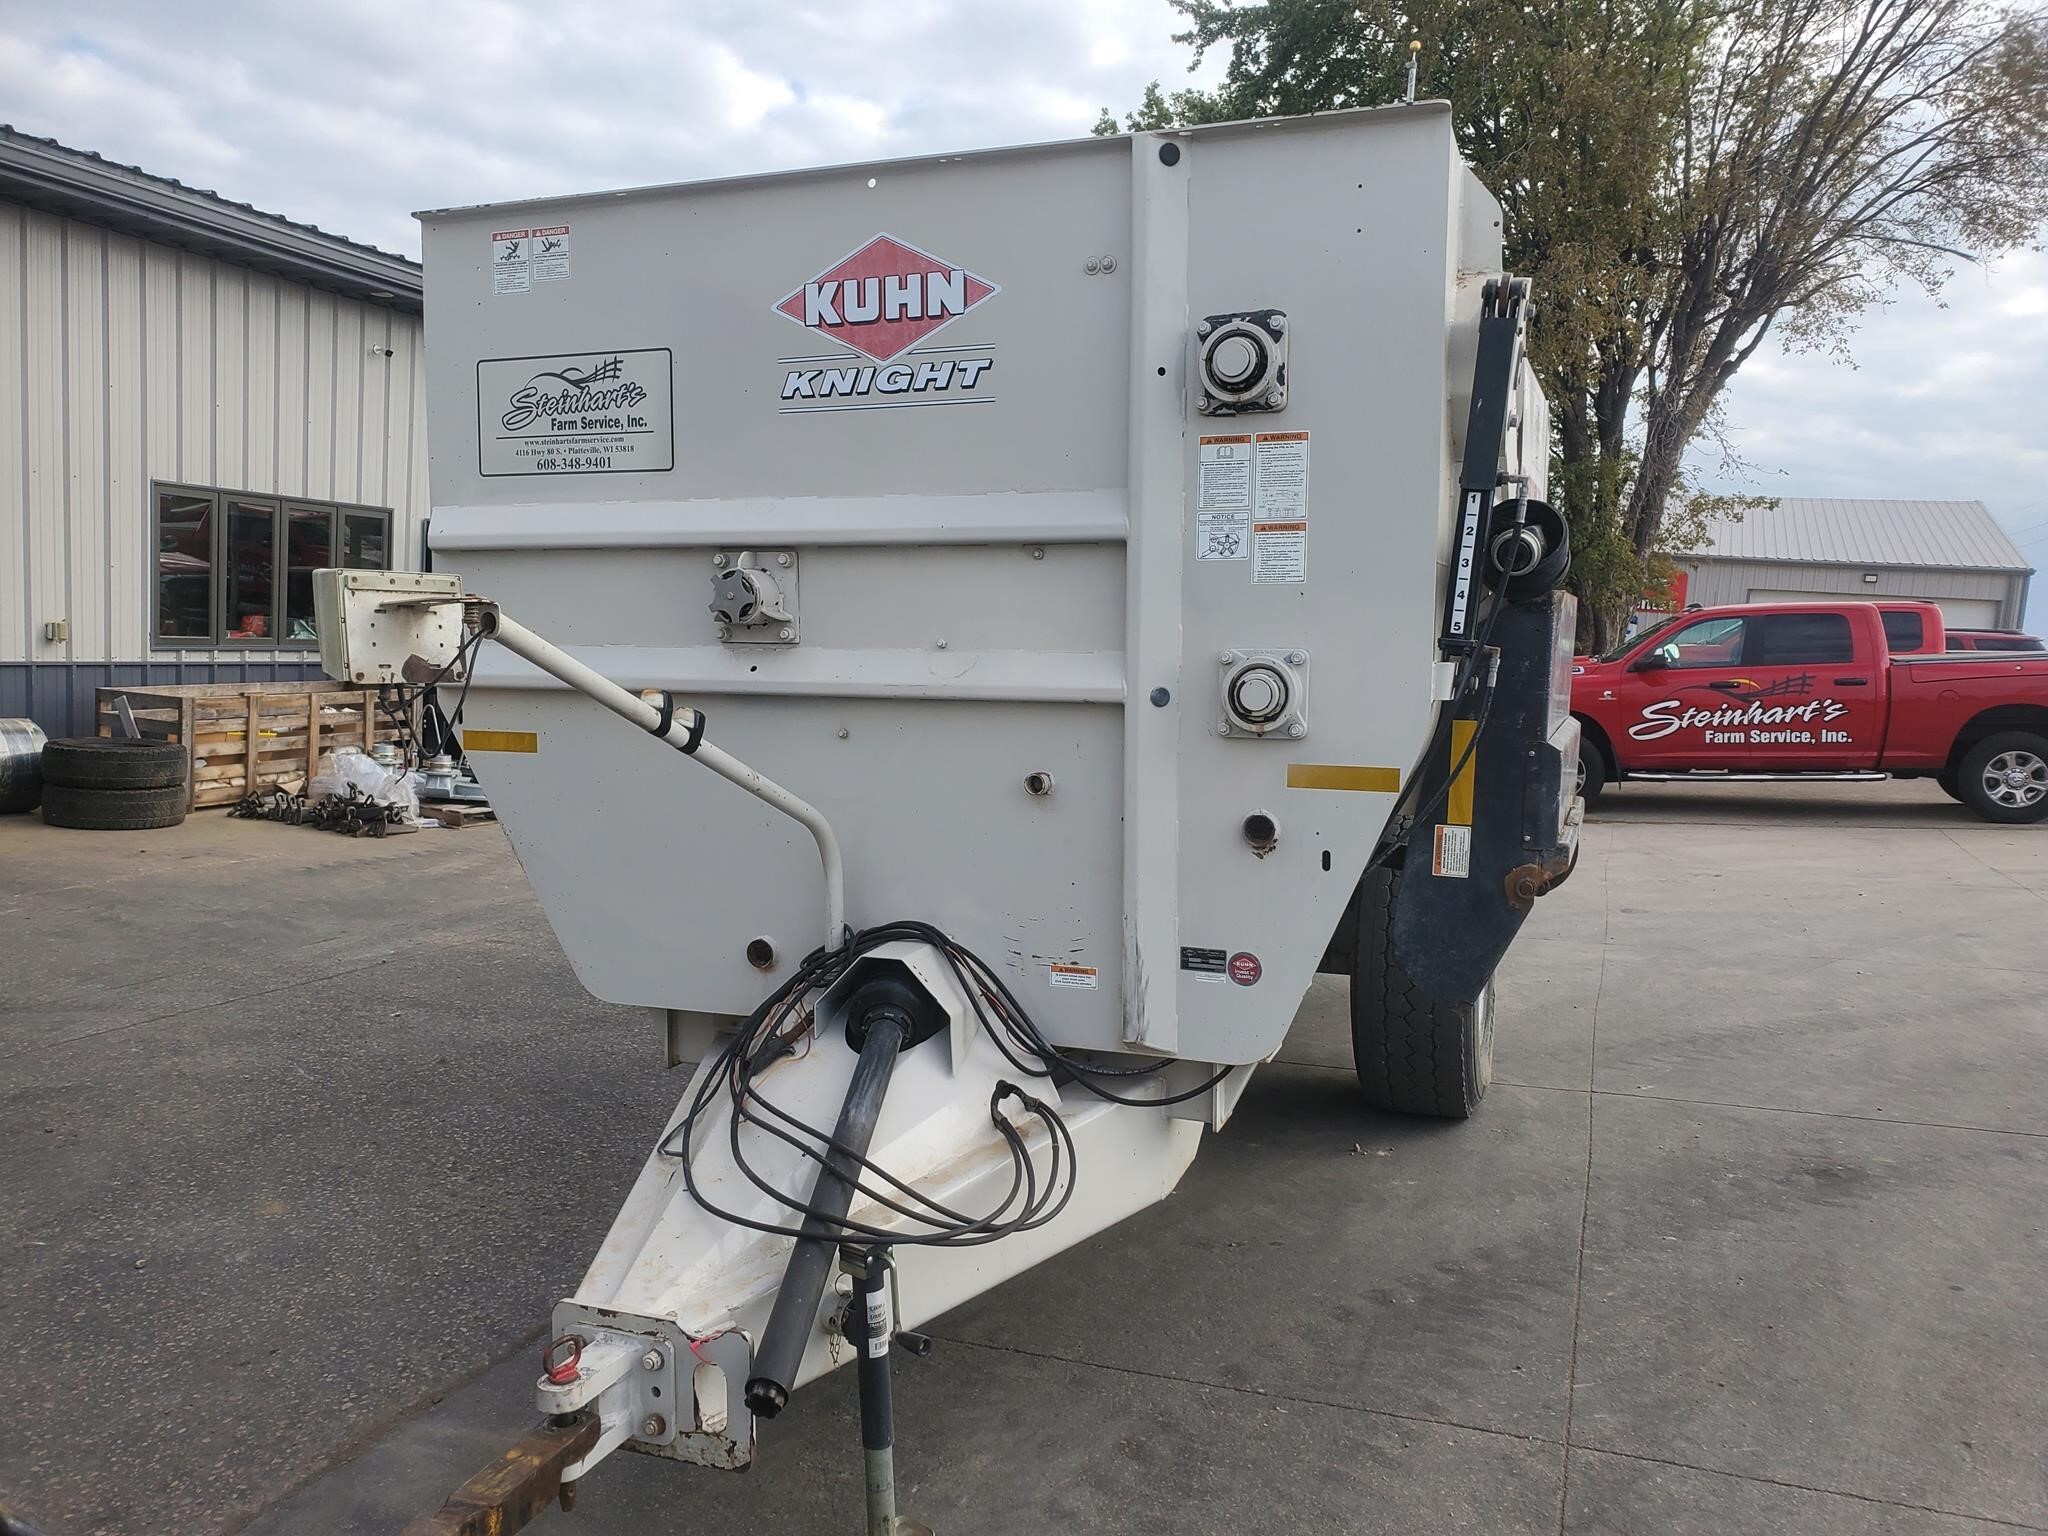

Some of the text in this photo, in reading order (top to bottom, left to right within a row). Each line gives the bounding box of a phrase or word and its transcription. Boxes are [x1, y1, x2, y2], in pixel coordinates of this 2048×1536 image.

[804, 269, 966, 327] KUHN
[780, 358, 994, 400] KNIGHT
[502, 382, 647, 431] Steinhart's
[551, 414, 648, 431] Farm Service, Inc.
[524, 436, 625, 446] www.steinhartsfarmservice.com
[531, 448, 545, 457] Hwy
[568, 446, 602, 455] Platteville,
[615, 445, 635, 453] 53818
[537, 456, 612, 471] 608-348-9401
[1470, 494, 1477, 503] 1
[1466, 527, 1474, 535] 2
[1461, 559, 1469, 567] 3
[1457, 590, 1465, 599] 4
[1453, 622, 1461, 631] 5
[1628, 699, 1849, 741] Steinhart's
[1705, 729, 1852, 745] Farm Service, Inc.
